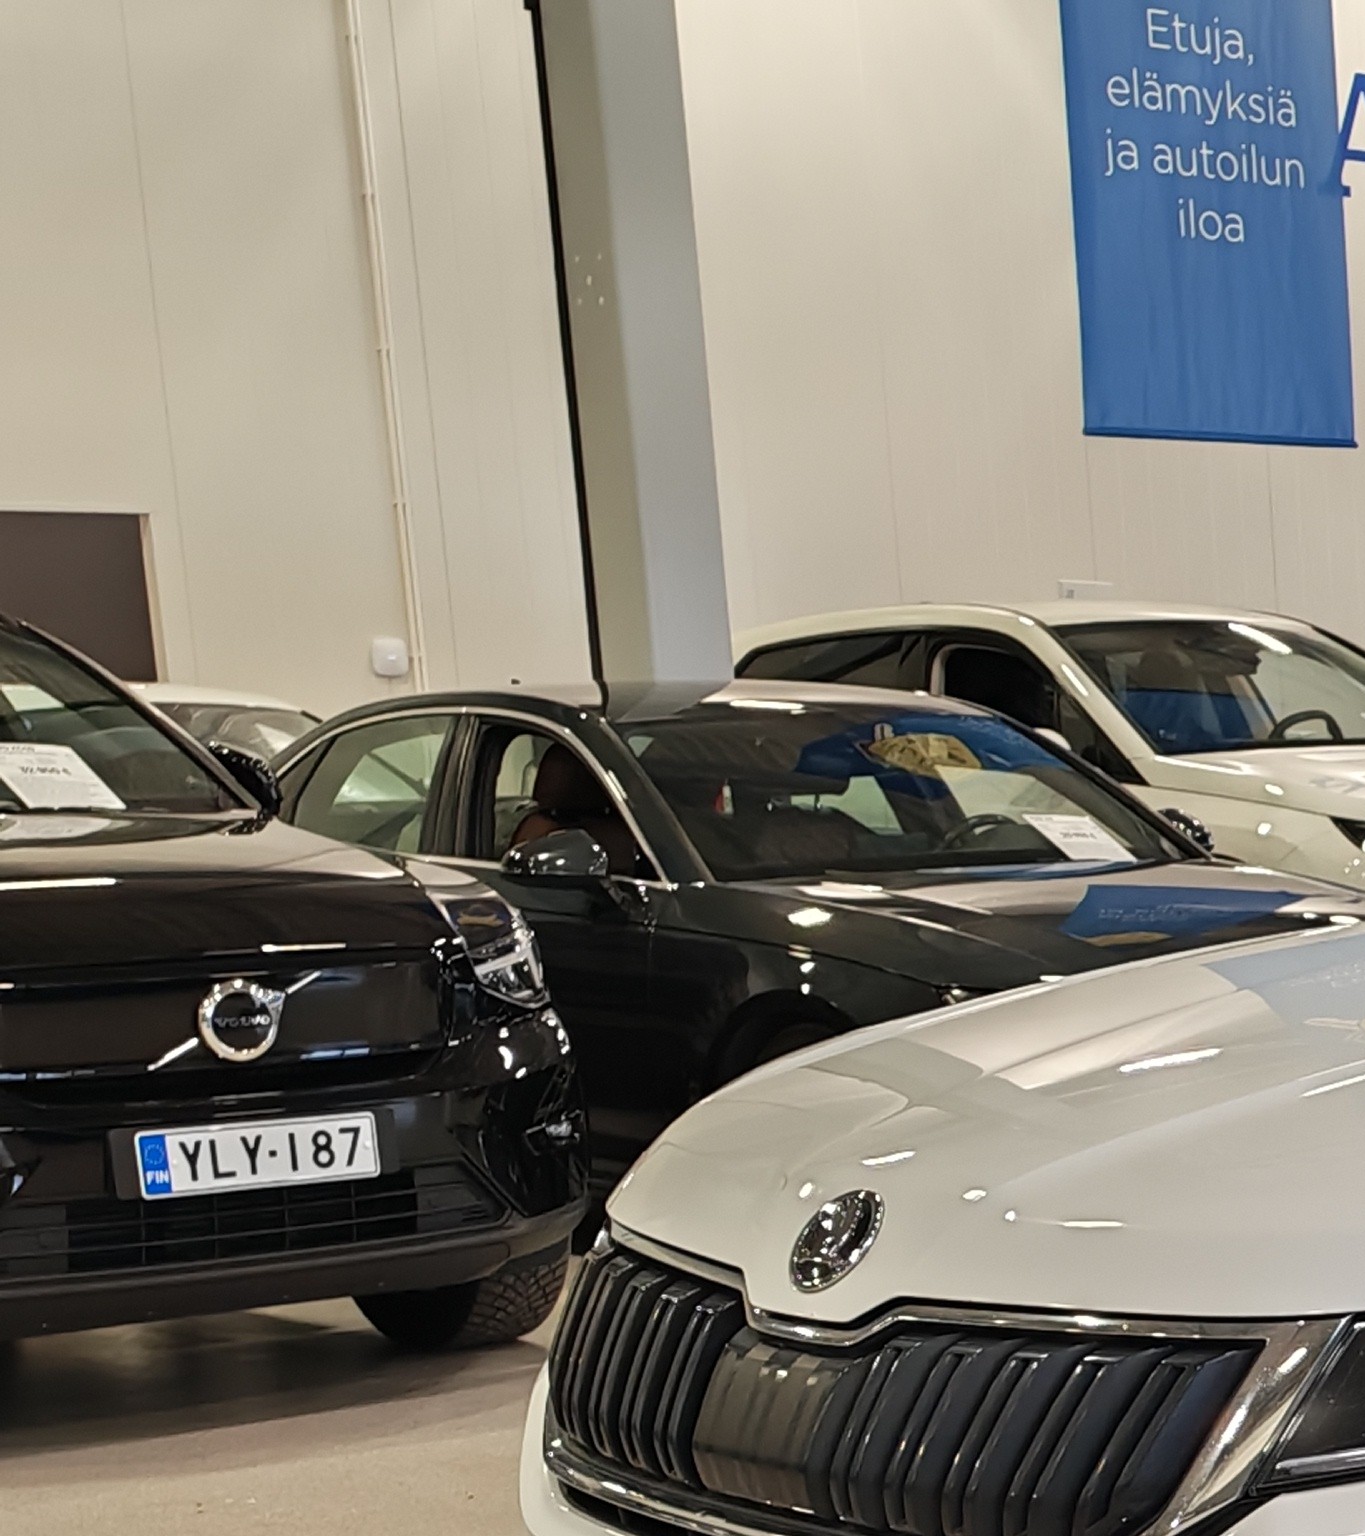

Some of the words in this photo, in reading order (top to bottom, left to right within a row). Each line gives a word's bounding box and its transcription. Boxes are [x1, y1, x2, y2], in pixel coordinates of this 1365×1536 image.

[1146, 8, 1254, 66] Etuja,
[1106, 67, 1297, 128] elämyksiä
[1105, 128, 1139, 177] ja
[1153, 141, 1305, 189] autoilun
[1178, 198, 1245, 243] iloa
[145, 1169, 169, 1186] FIN
[178, 1126, 362, 1182] YLY-187
